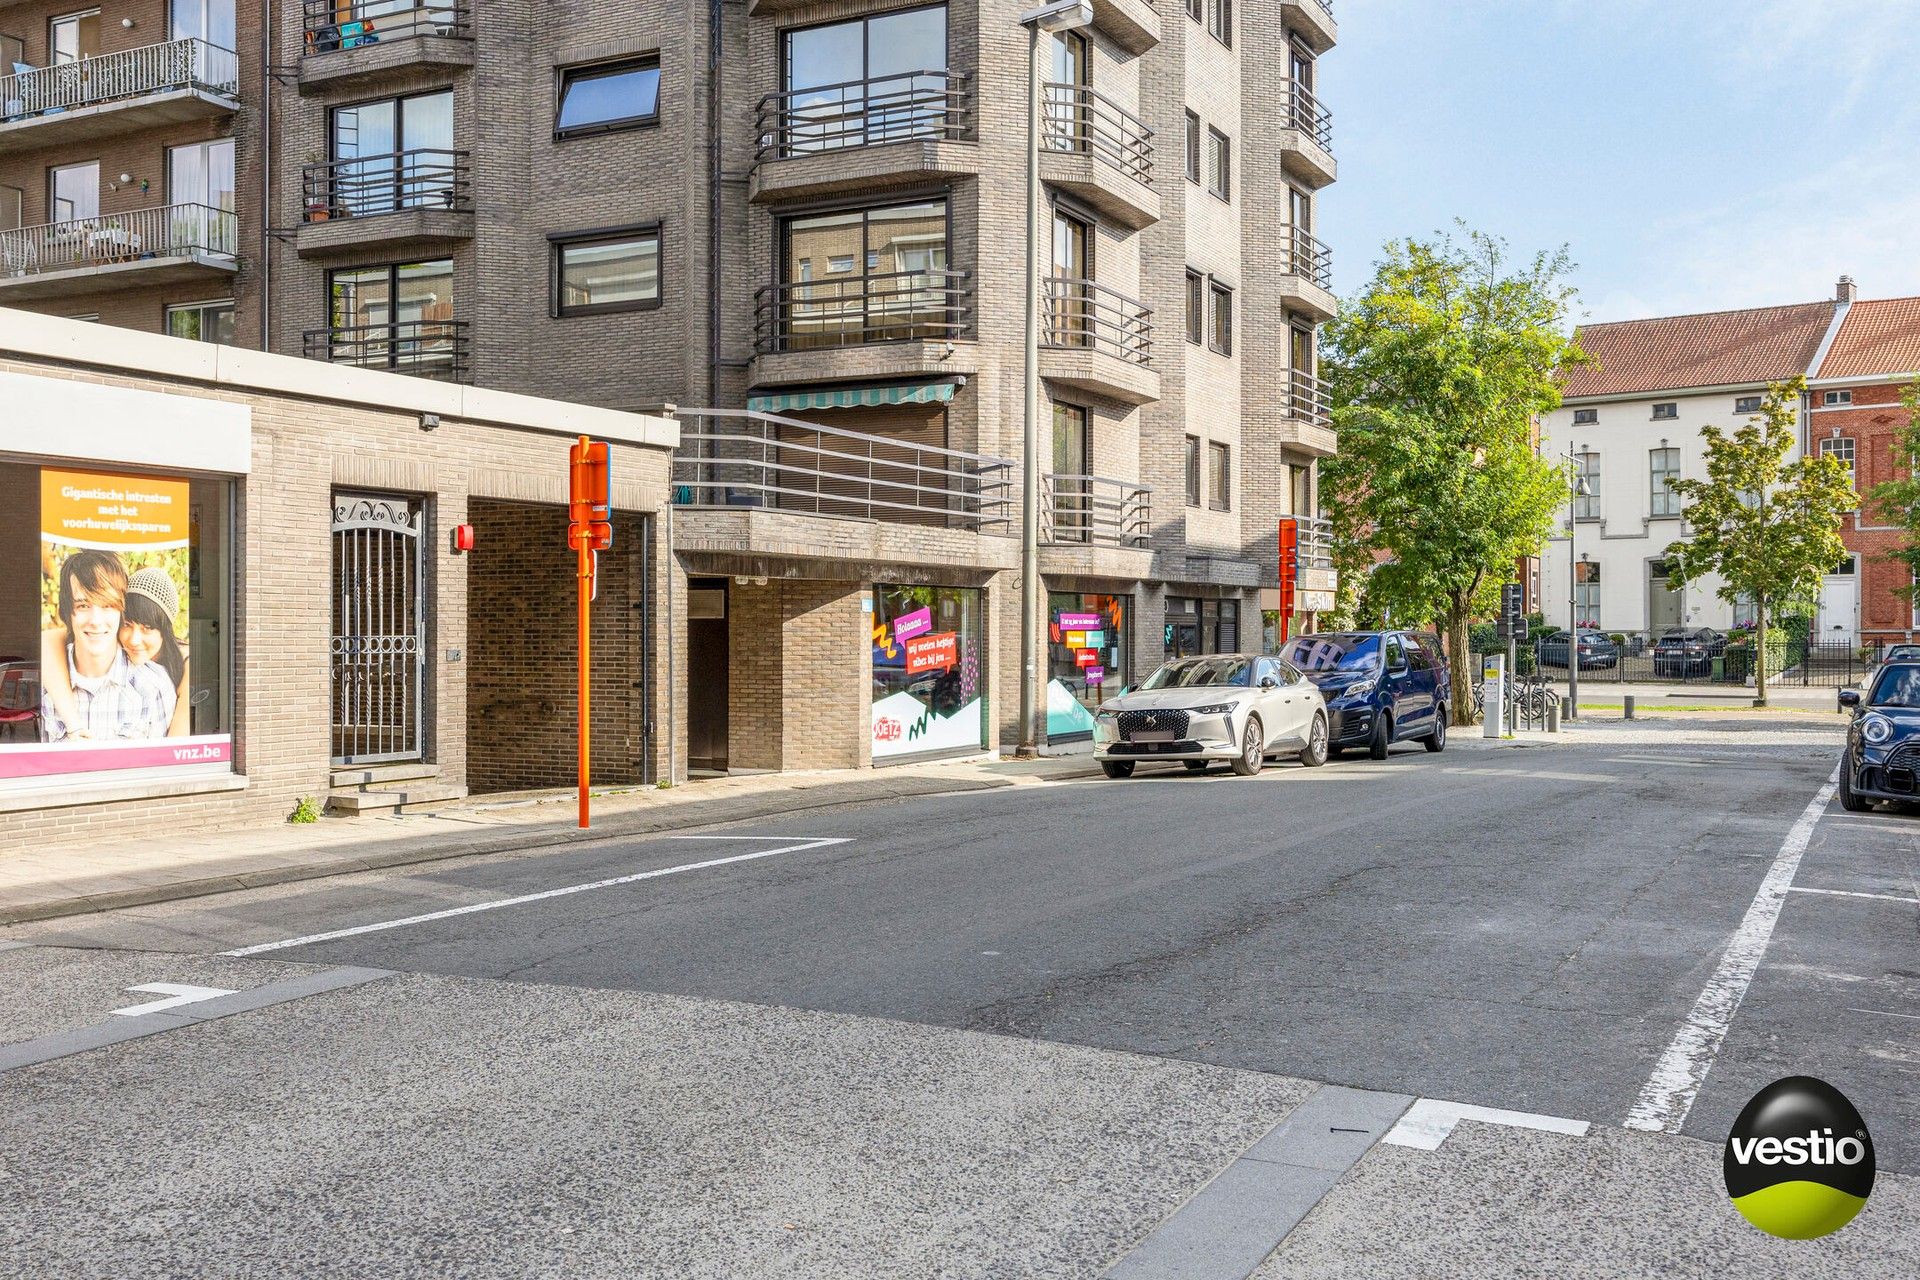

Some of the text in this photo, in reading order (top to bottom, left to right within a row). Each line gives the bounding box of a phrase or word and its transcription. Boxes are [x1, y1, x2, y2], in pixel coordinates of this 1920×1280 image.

[62, 487, 171, 504] Gigantische intresten
[99, 504, 138, 516] met het
[927, 654, 935, 665] bij
[174, 745, 220, 759] vnz.be
